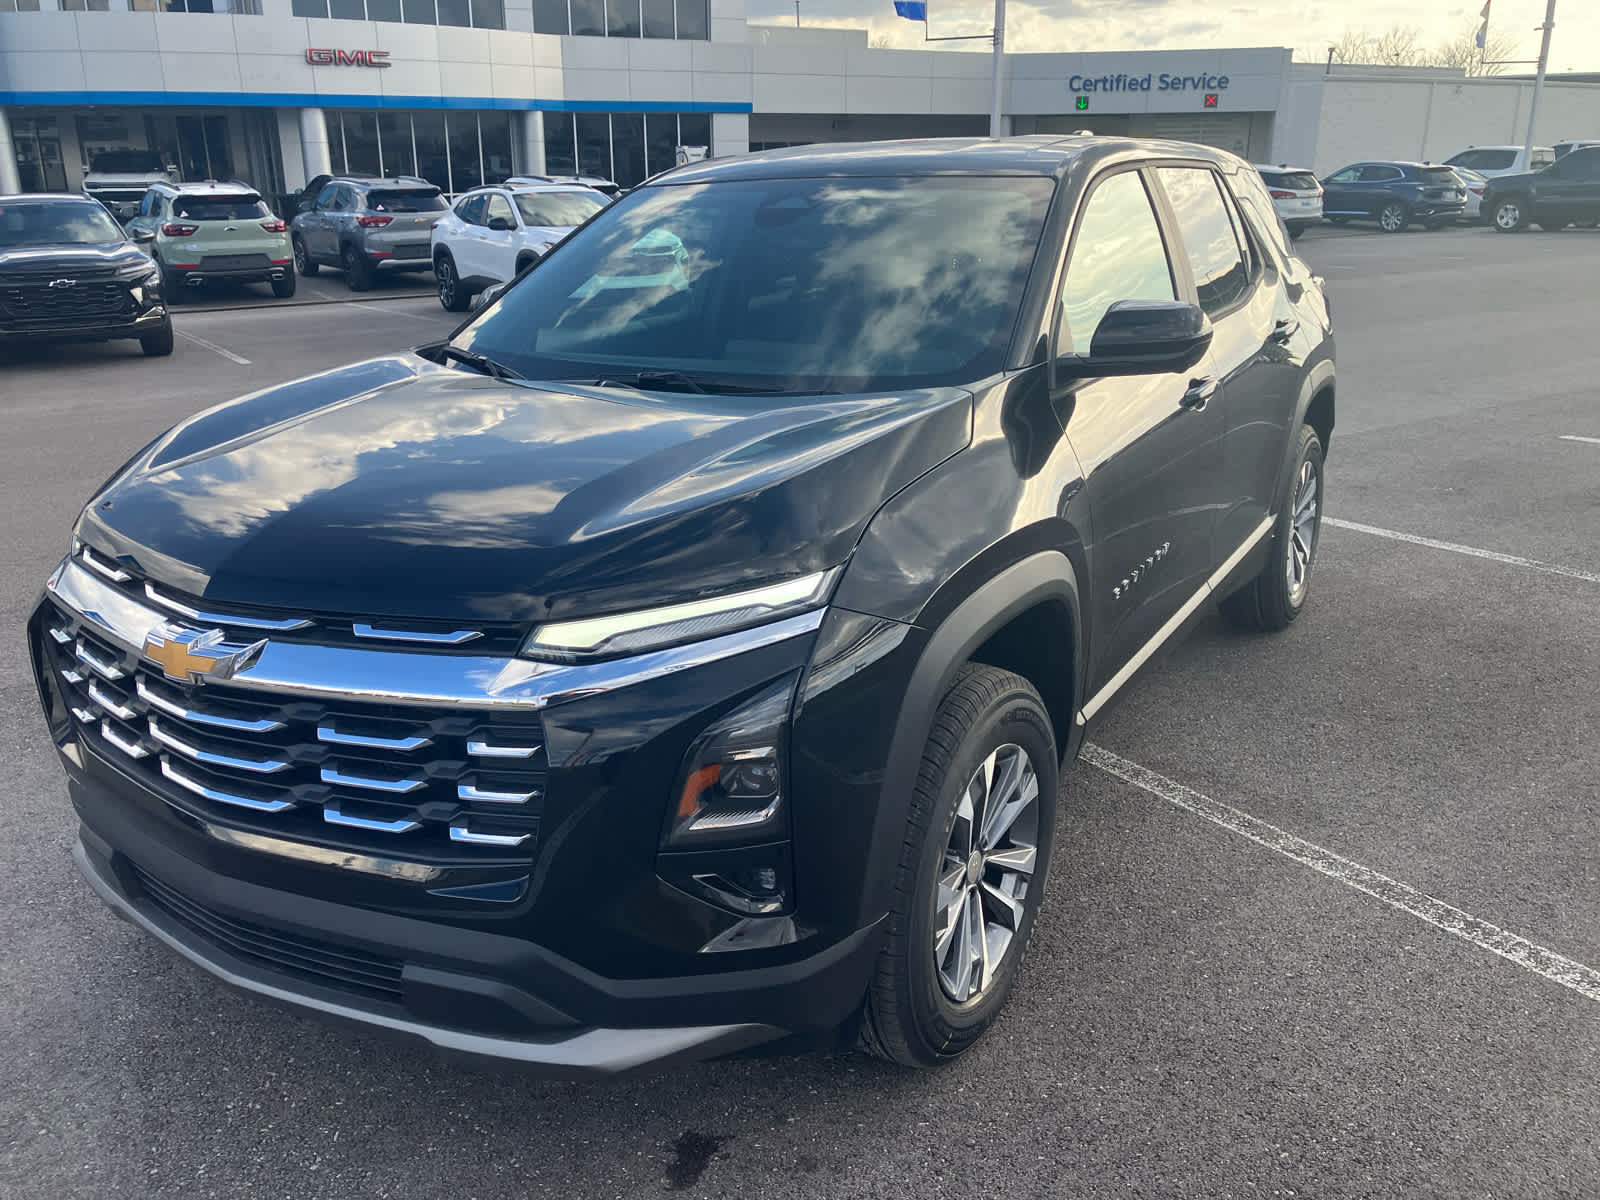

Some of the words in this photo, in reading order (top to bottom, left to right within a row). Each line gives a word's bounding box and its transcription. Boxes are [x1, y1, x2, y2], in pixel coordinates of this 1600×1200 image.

[306, 48, 392, 68] GMC
[1069, 74, 1152, 92] Certified
[1158, 73, 1229, 91] Service
